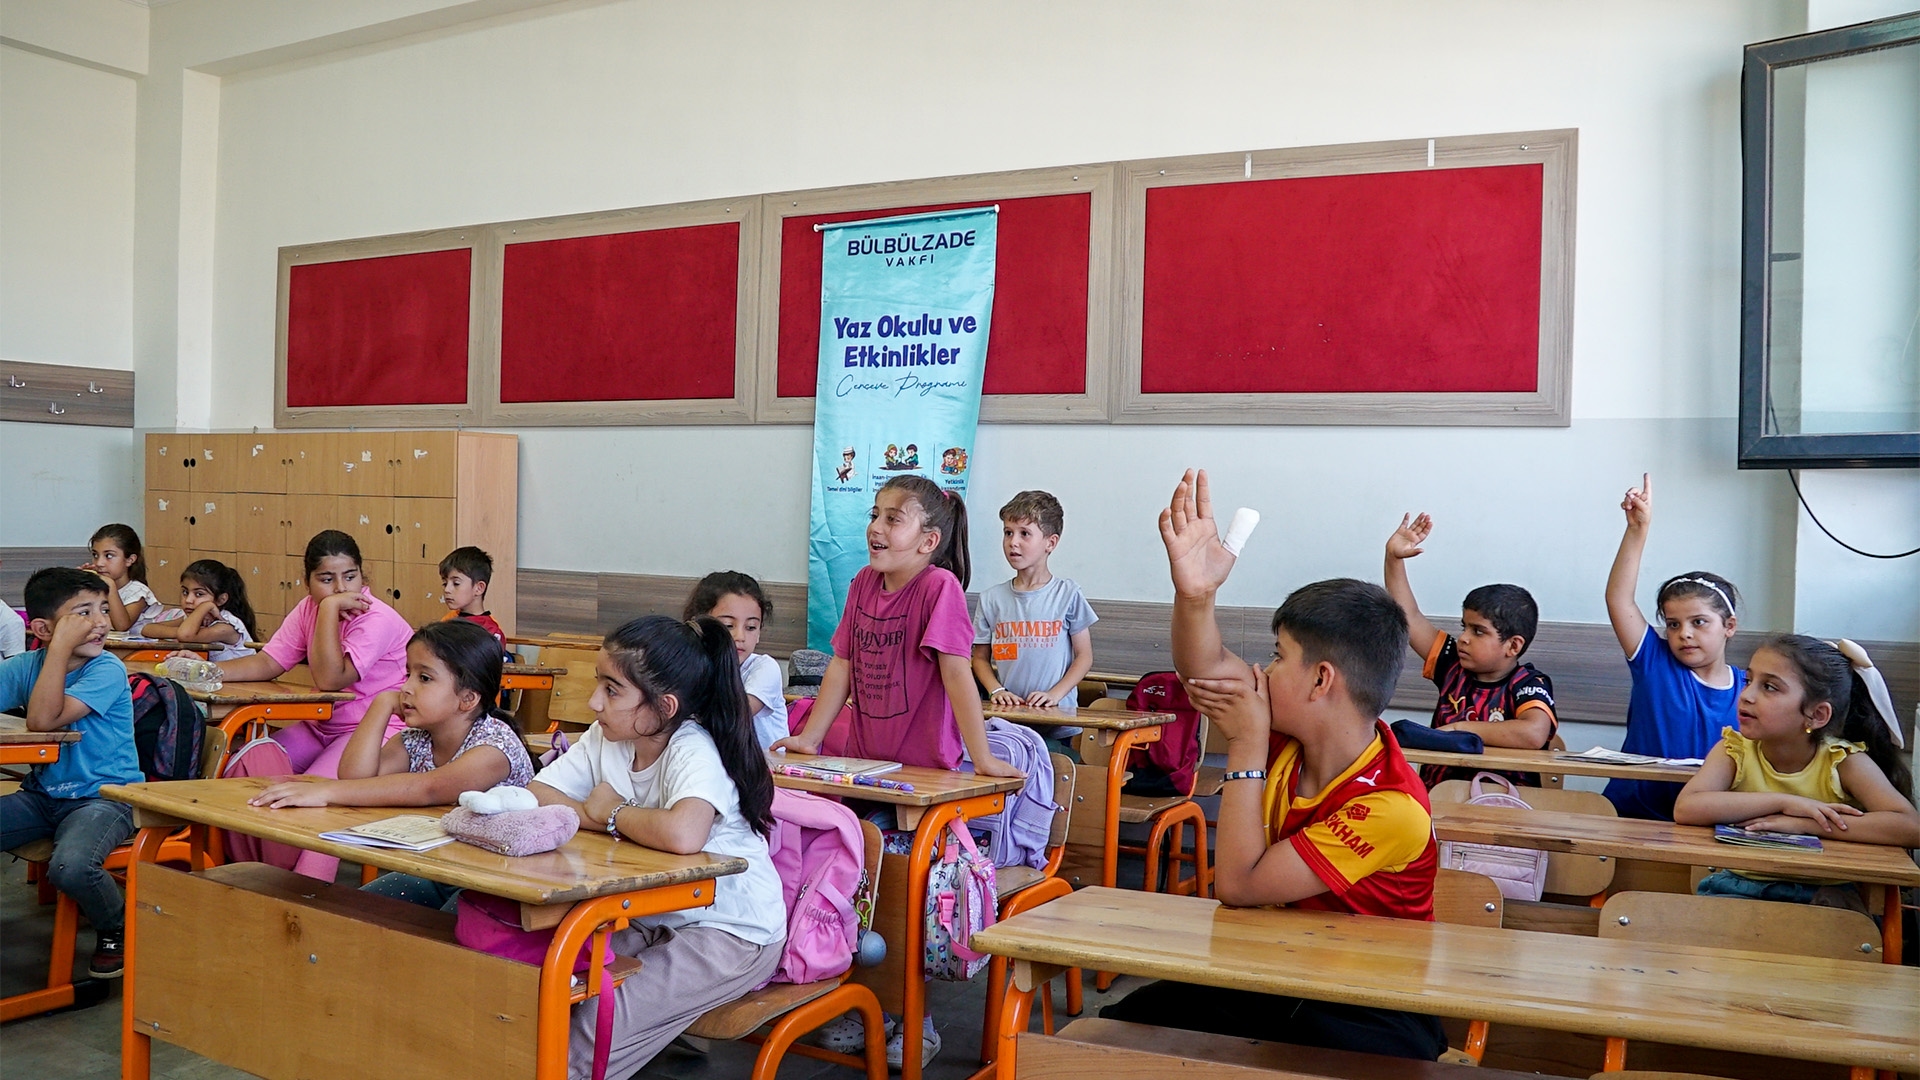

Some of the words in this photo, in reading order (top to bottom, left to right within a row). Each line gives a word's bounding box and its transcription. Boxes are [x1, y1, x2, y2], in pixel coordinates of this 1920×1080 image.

[848, 230, 976, 256] BÜLBÜLZADE
[885, 254, 934, 267] VAKFI
[834, 317, 872, 339] Yaz
[877, 313, 942, 338] Okulu
[948, 315, 977, 333] ve
[844, 343, 960, 368] Etkinlikler
[995, 620, 1062, 639] SUMMER
